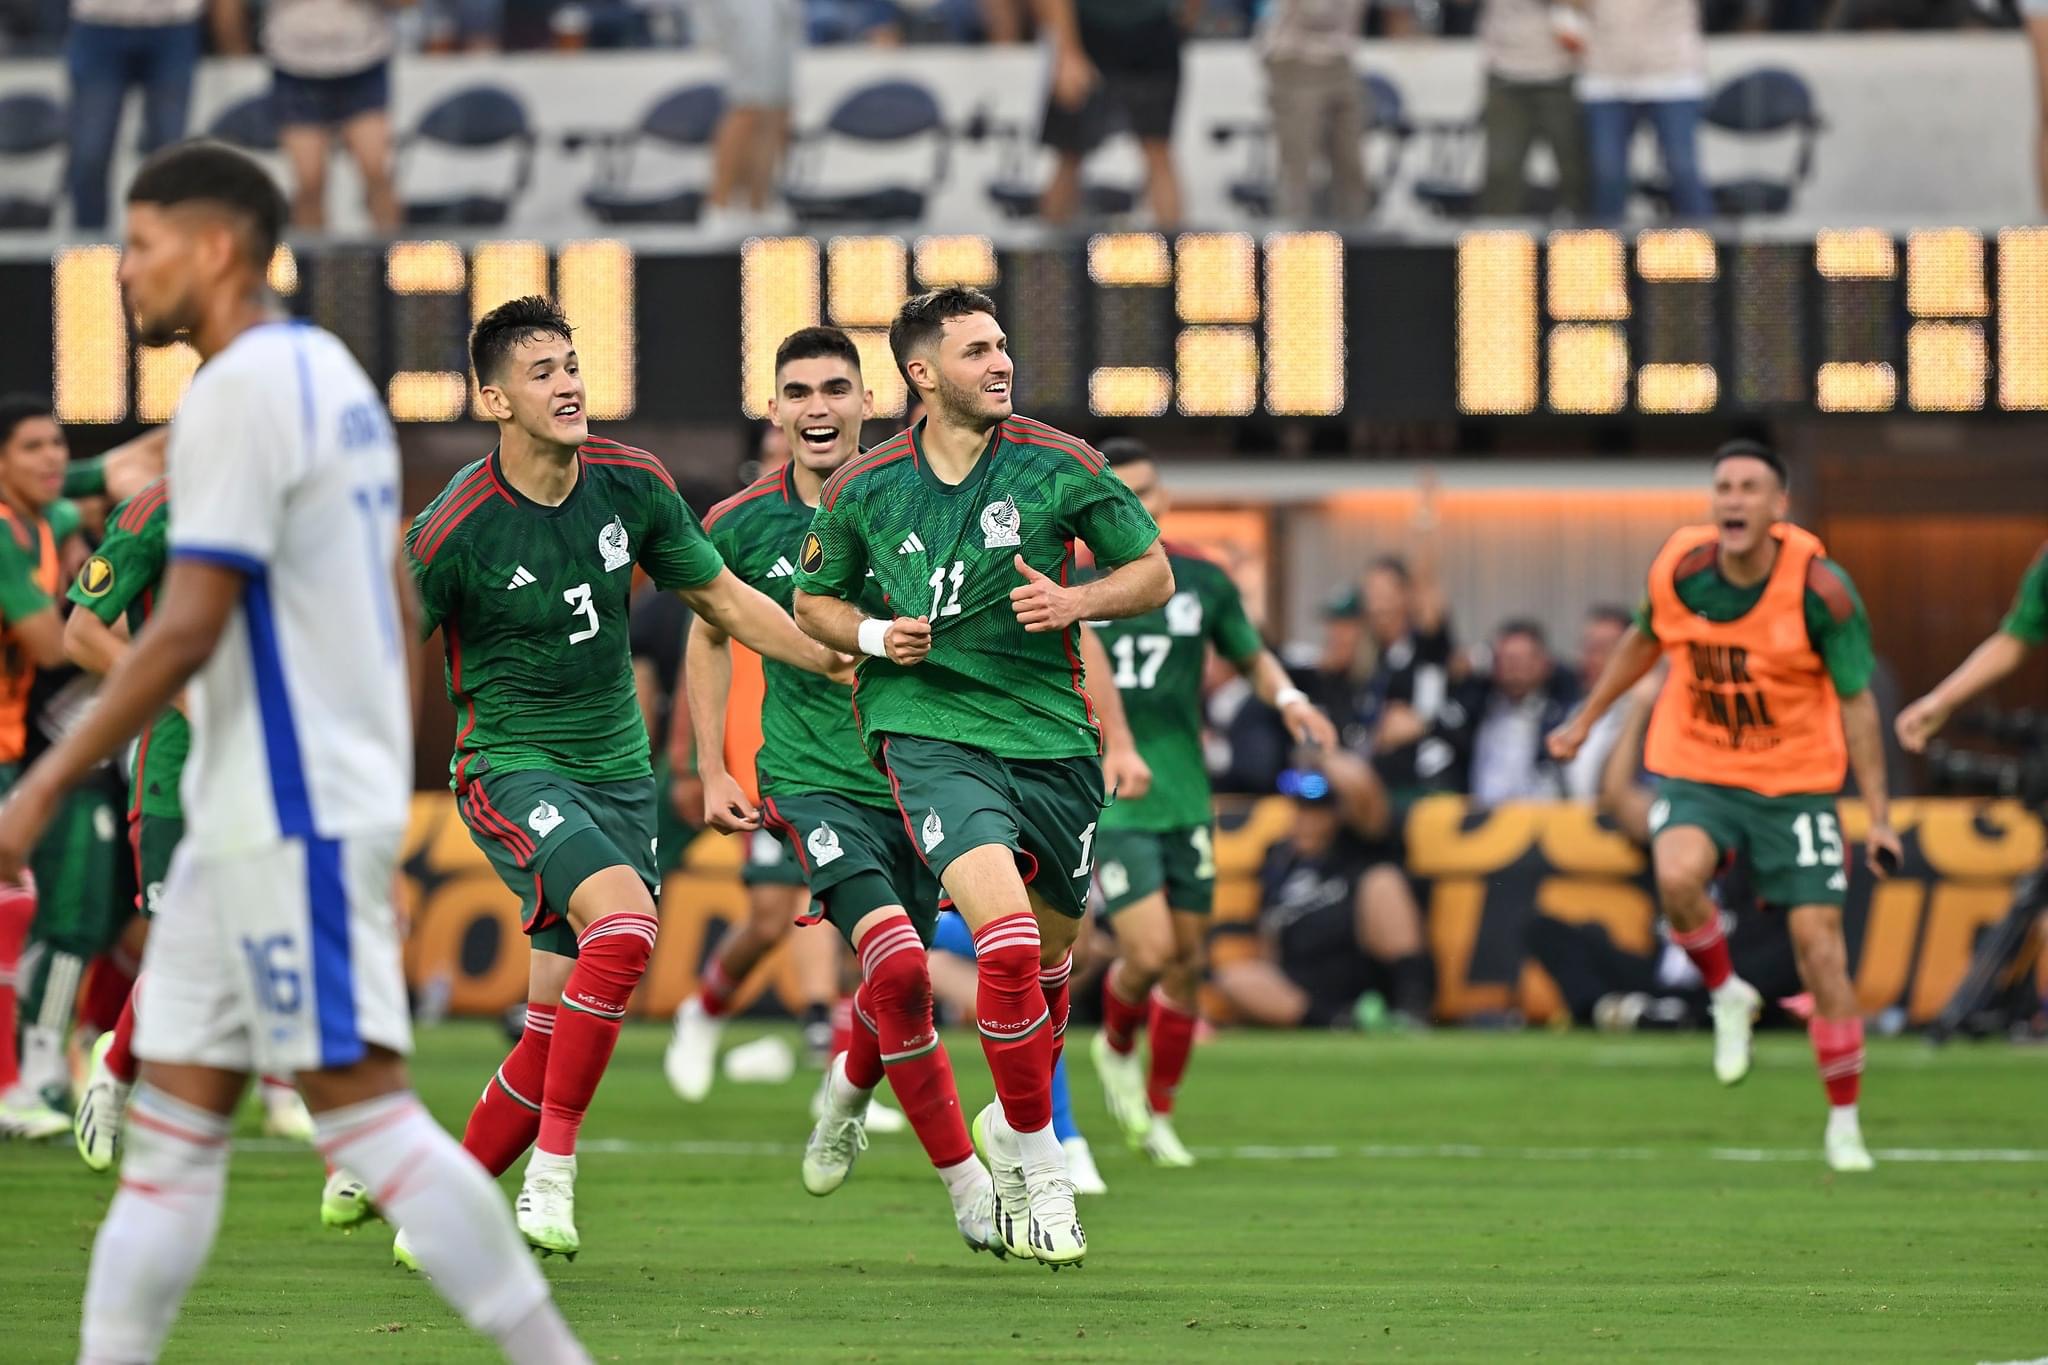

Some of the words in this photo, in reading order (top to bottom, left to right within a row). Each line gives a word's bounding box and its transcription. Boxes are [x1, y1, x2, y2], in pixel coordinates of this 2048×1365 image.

[563, 582, 600, 646] 3
[928, 560, 964, 624] 11
[1111, 634, 1173, 690] 17
[1072, 822, 1097, 878] 1
[1792, 811, 1844, 867] 15
[240, 933, 303, 1015] 16
[981, 1018, 1030, 1030] MÉXICO
